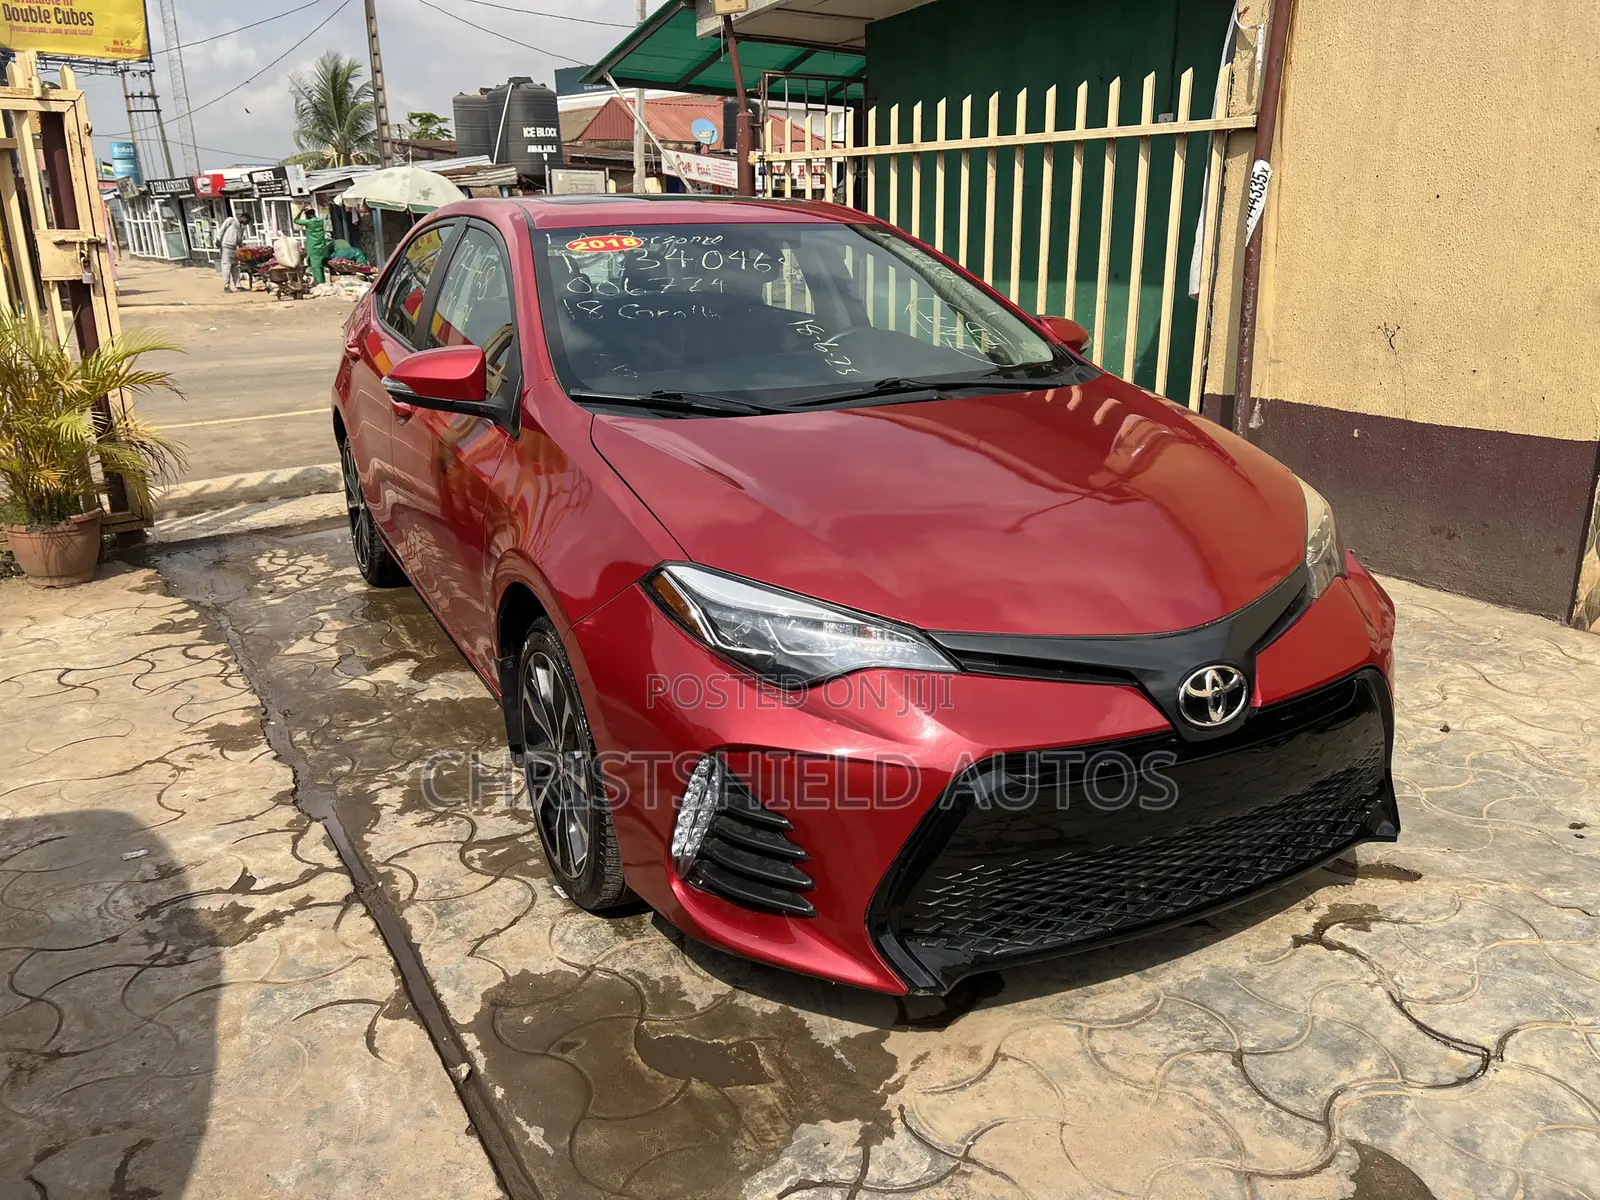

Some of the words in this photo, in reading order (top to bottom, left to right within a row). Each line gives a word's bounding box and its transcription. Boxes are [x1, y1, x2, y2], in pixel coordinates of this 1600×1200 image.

[2, 3, 52, 24] Double
[54, 7, 95, 26] Cubes
[522, 127, 536, 138] ICE
[536, 127, 558, 138] BLOCK
[527, 144, 557, 153] AVAILABLE
[571, 237, 639, 252] 2018
